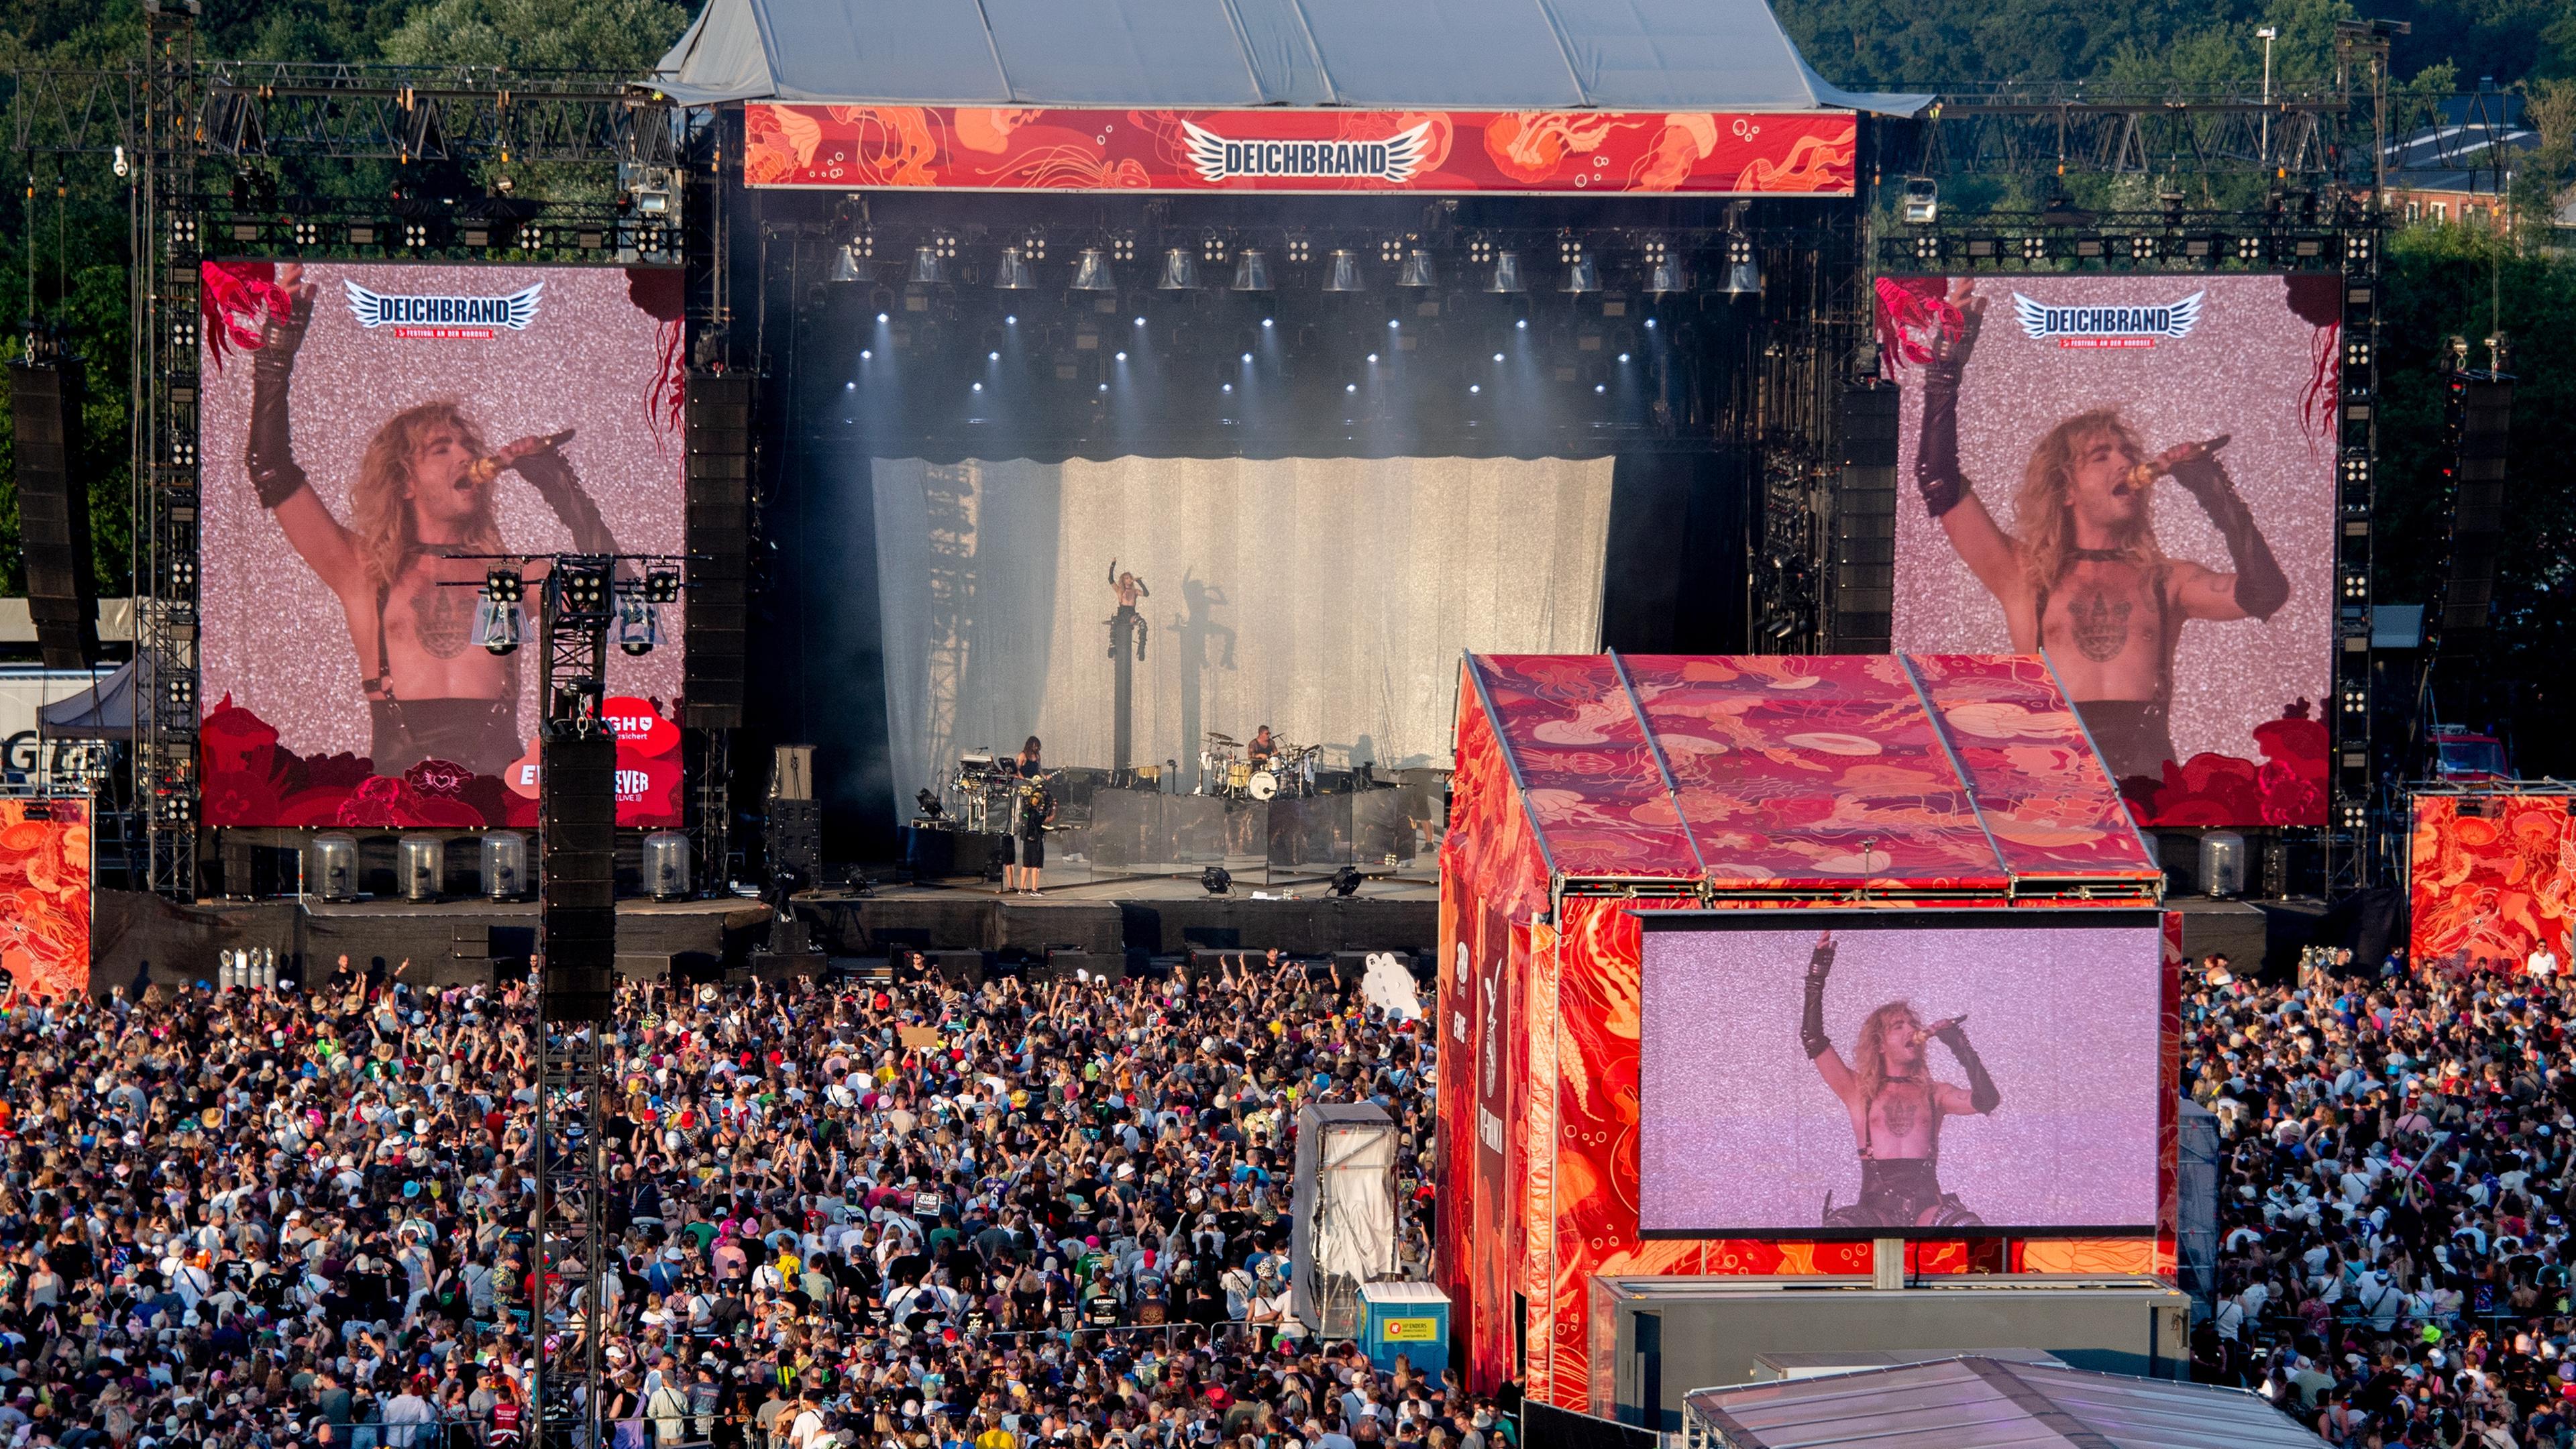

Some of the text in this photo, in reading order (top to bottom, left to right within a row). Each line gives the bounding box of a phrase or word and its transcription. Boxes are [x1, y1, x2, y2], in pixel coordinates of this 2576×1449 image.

[1225, 143, 1387, 174] DEICHBRAND
[379, 297, 510, 323] DEICHBRAND
[2045, 309, 2170, 333] DEICHBRAND
[601, 716, 637, 731] GH
[520, 765, 540, 785] E
[615, 769, 649, 794] EVER
